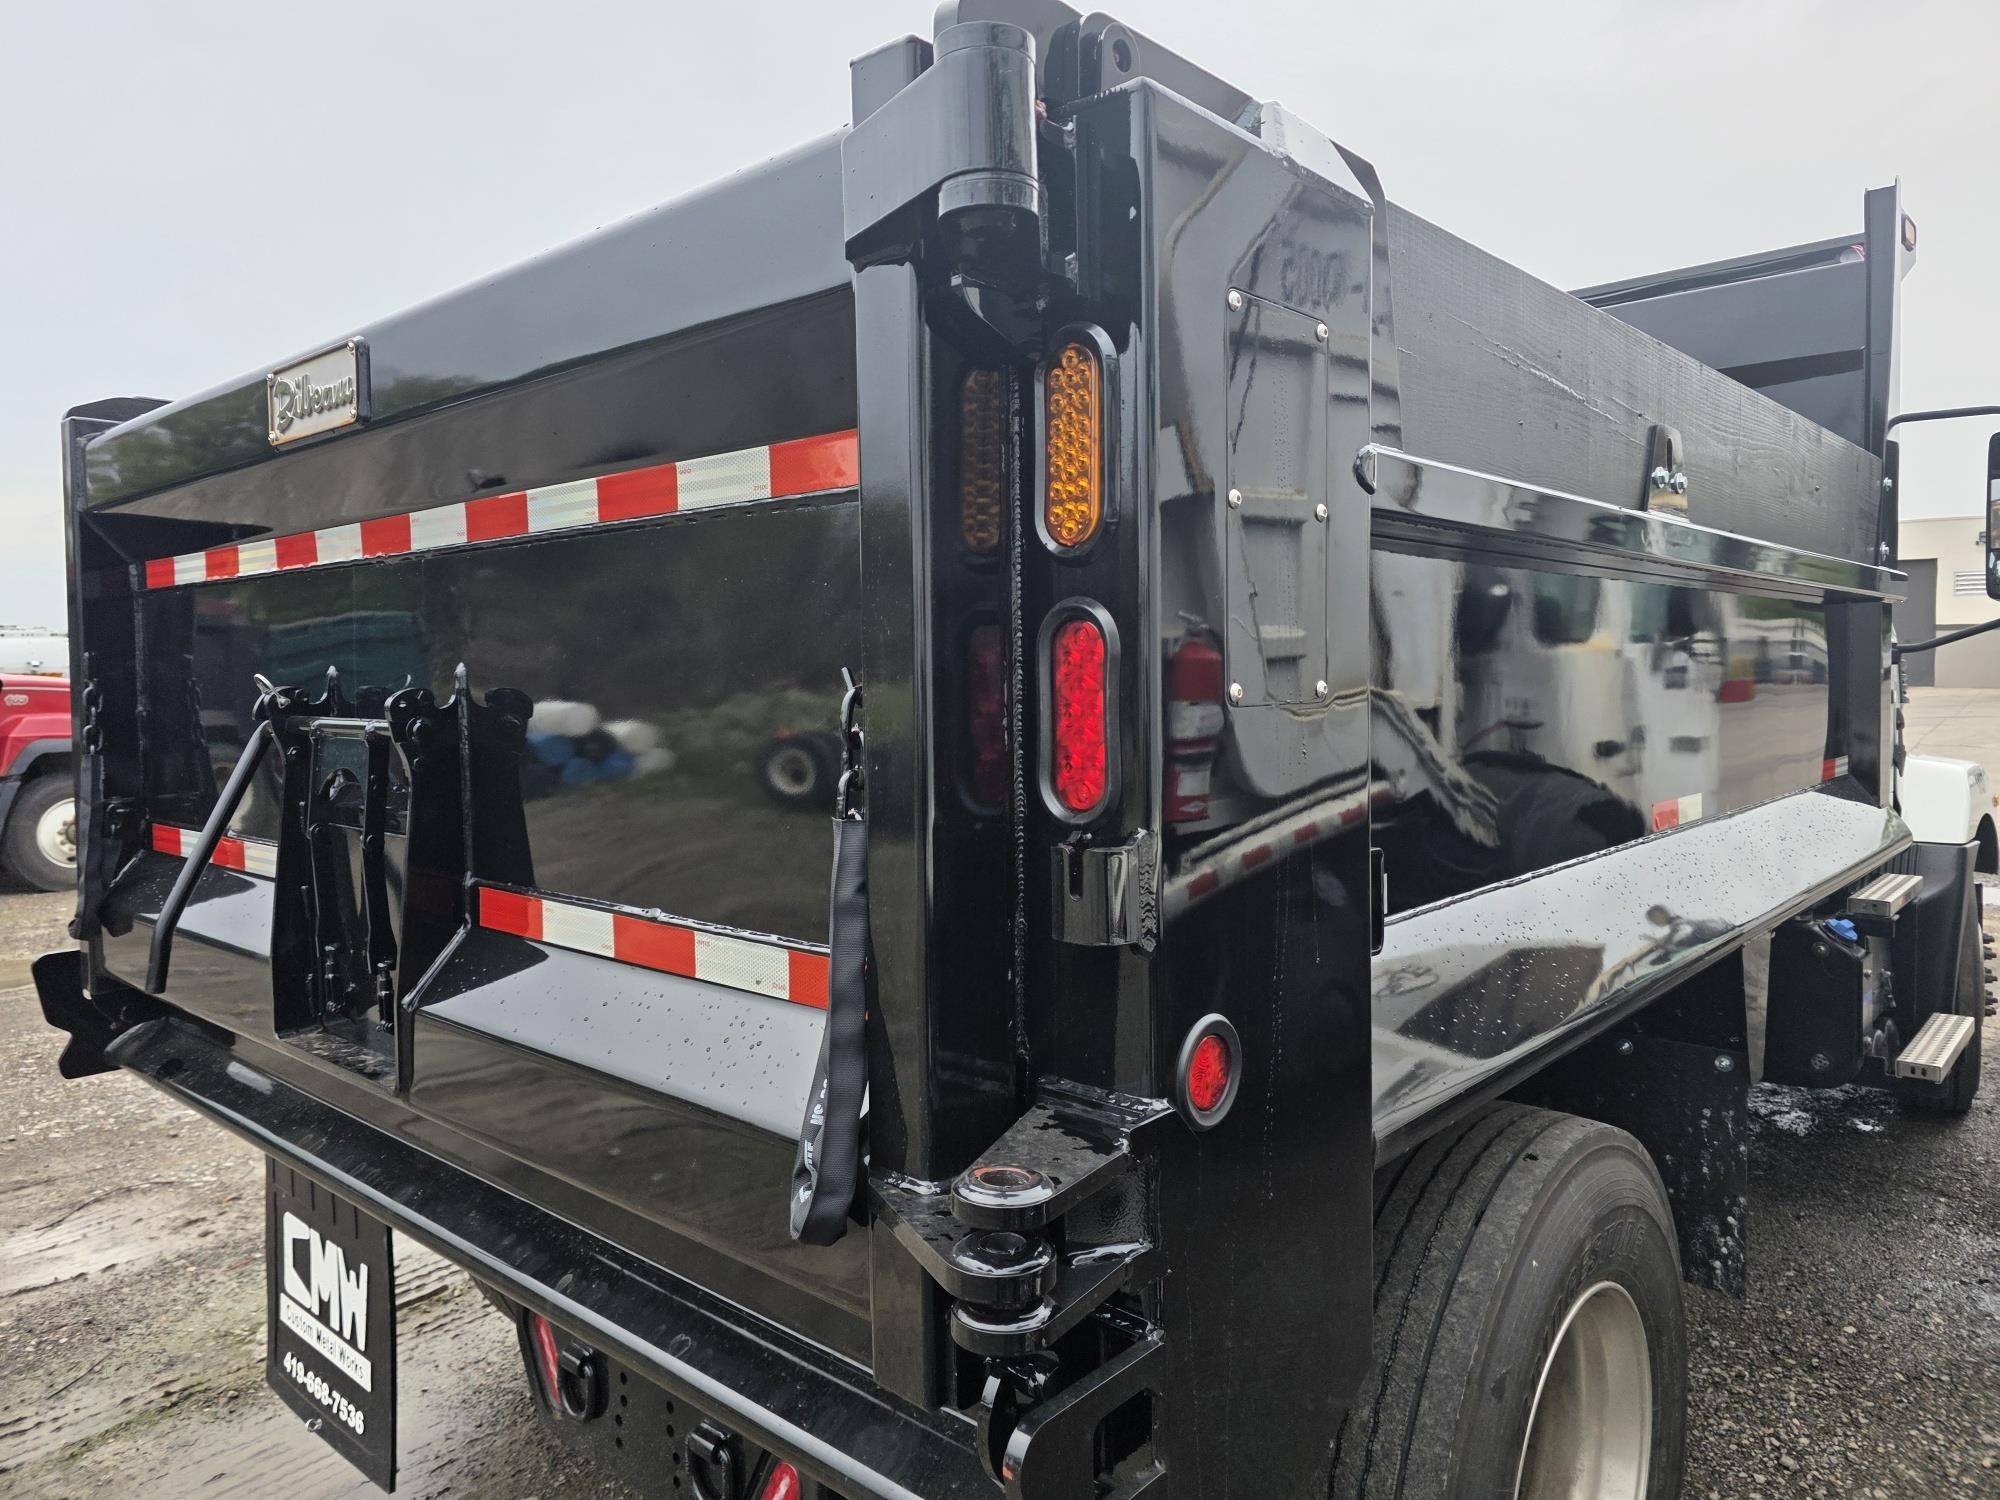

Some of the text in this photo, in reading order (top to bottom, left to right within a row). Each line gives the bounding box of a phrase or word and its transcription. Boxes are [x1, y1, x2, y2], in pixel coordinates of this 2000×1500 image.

[283, 1212, 368, 1352] CMW
[286, 1303, 364, 1380] Custom Metal Works
